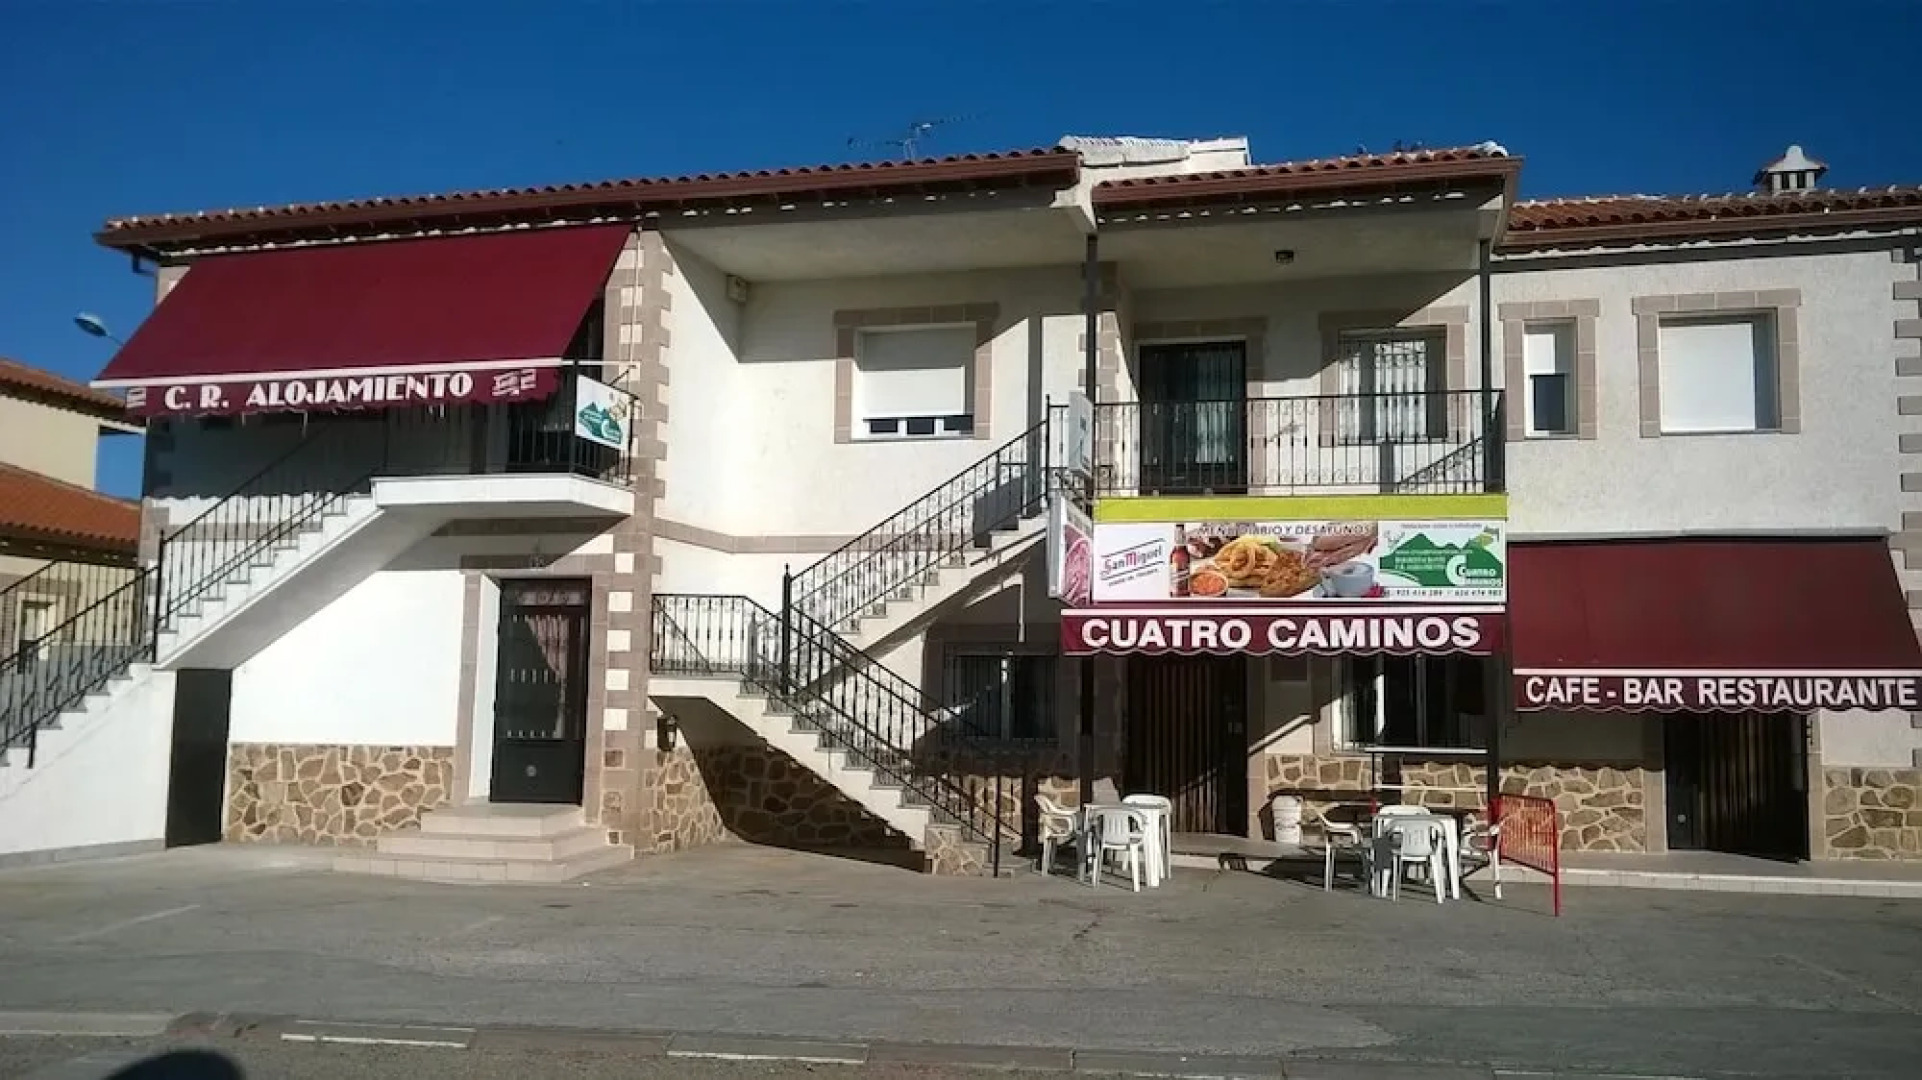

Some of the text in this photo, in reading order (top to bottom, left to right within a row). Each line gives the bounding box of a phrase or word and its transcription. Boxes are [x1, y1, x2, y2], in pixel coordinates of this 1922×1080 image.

[165, 385, 191, 410] C.
[200, 384, 229, 408] R.
[246, 372, 474, 406] ALOJAMIENTO
[1081, 617, 1481, 648] CUATRO CAMINOS
[1525, 677, 1600, 704] CAFE
[1623, 677, 1684, 705] BAR
[1698, 678, 1917, 706] RESTAURANTE
